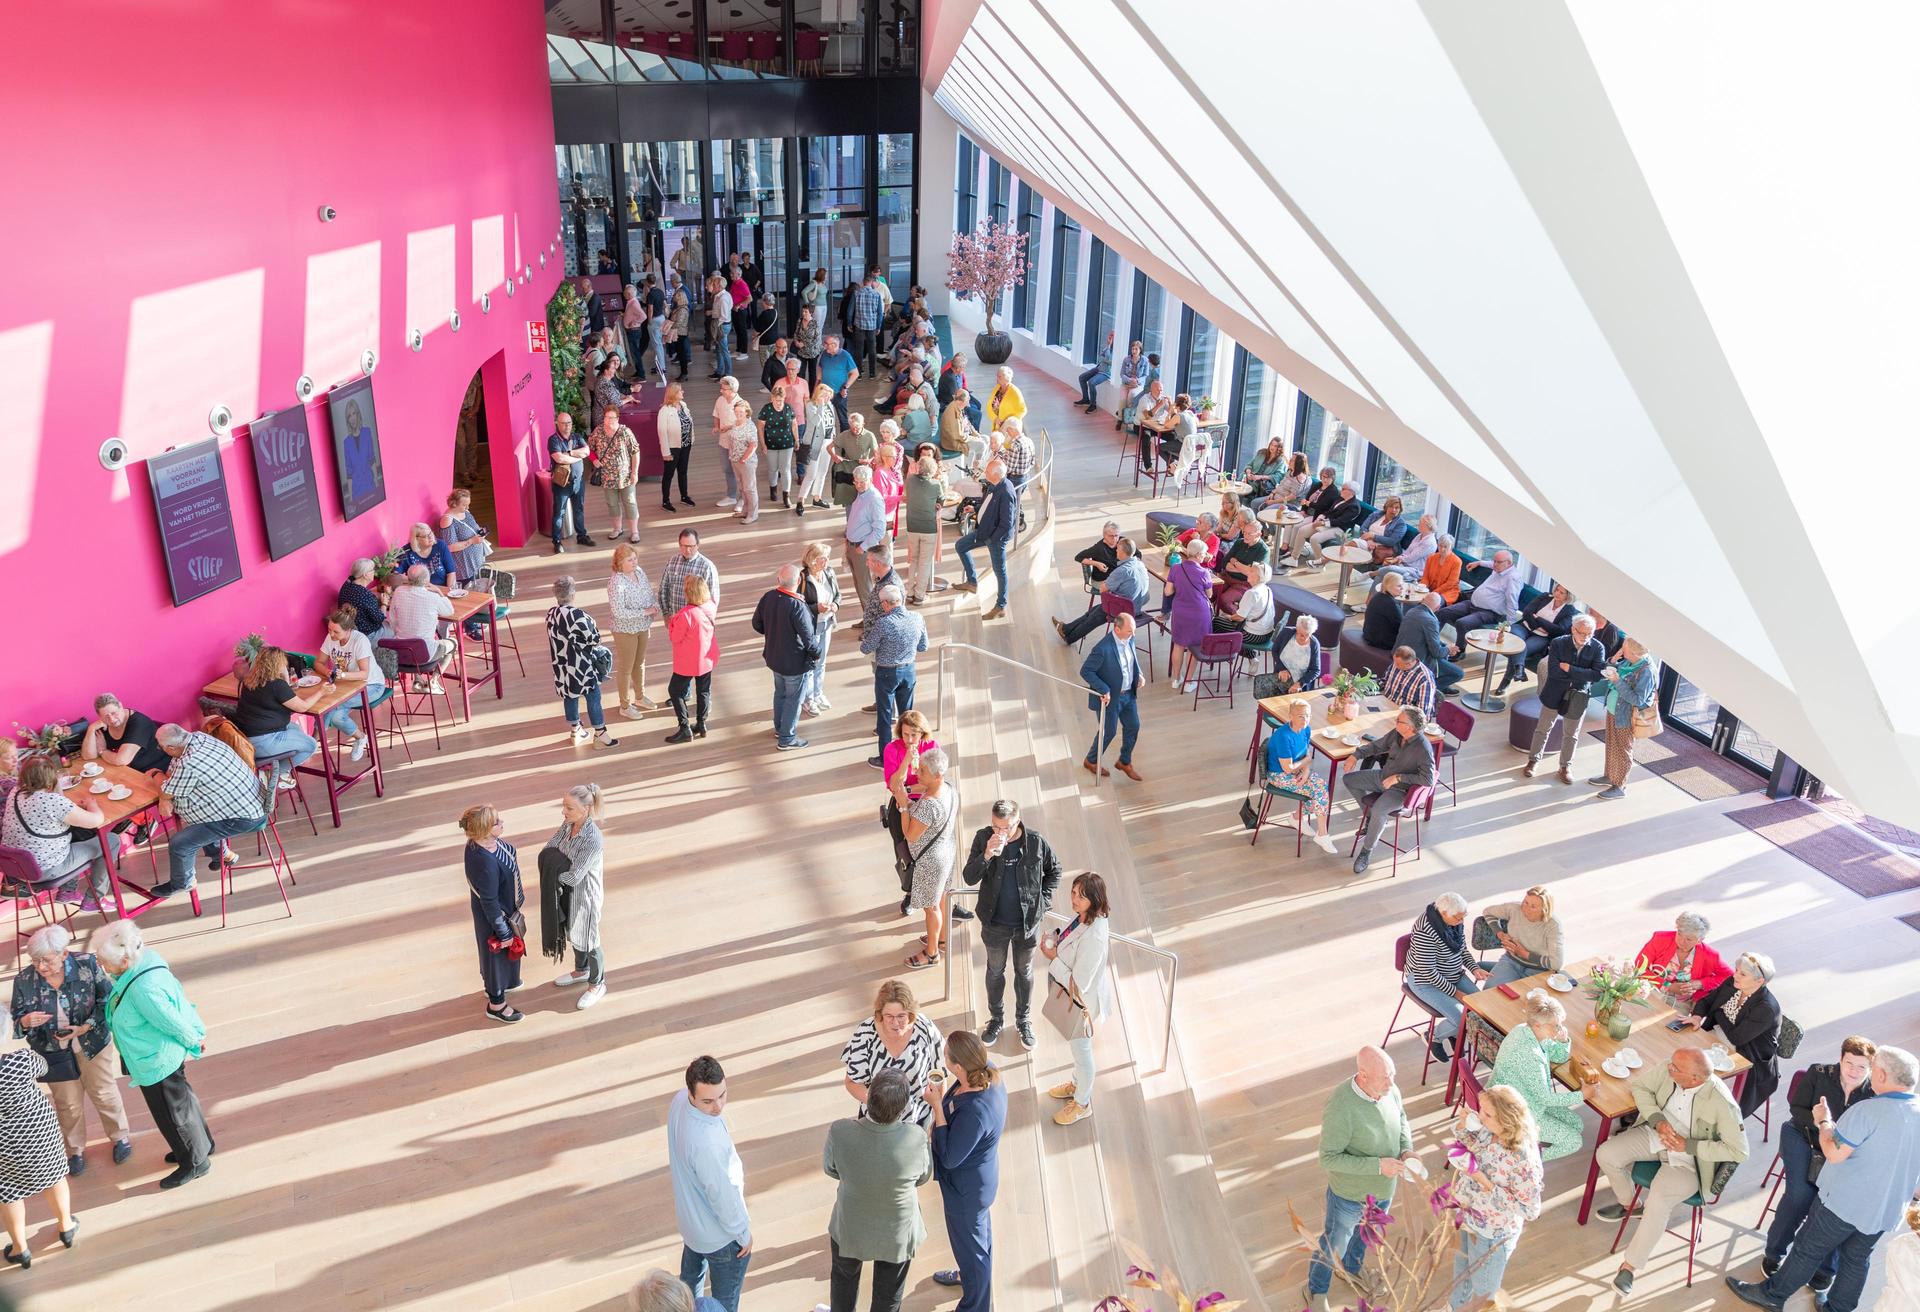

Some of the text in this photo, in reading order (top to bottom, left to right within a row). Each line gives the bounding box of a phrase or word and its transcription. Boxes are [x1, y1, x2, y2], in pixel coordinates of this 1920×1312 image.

[259, 427, 305, 467] STOEP
[166, 456, 208, 475] KAARTEN MET
[170, 465, 206, 482] VOORRANG
[176, 475, 203, 490] BOEKEN?
[168, 502, 222, 527] VAN HET THEATER!
[173, 496, 216, 516] WORD VRIEND
[188, 555, 224, 581] STOEP
